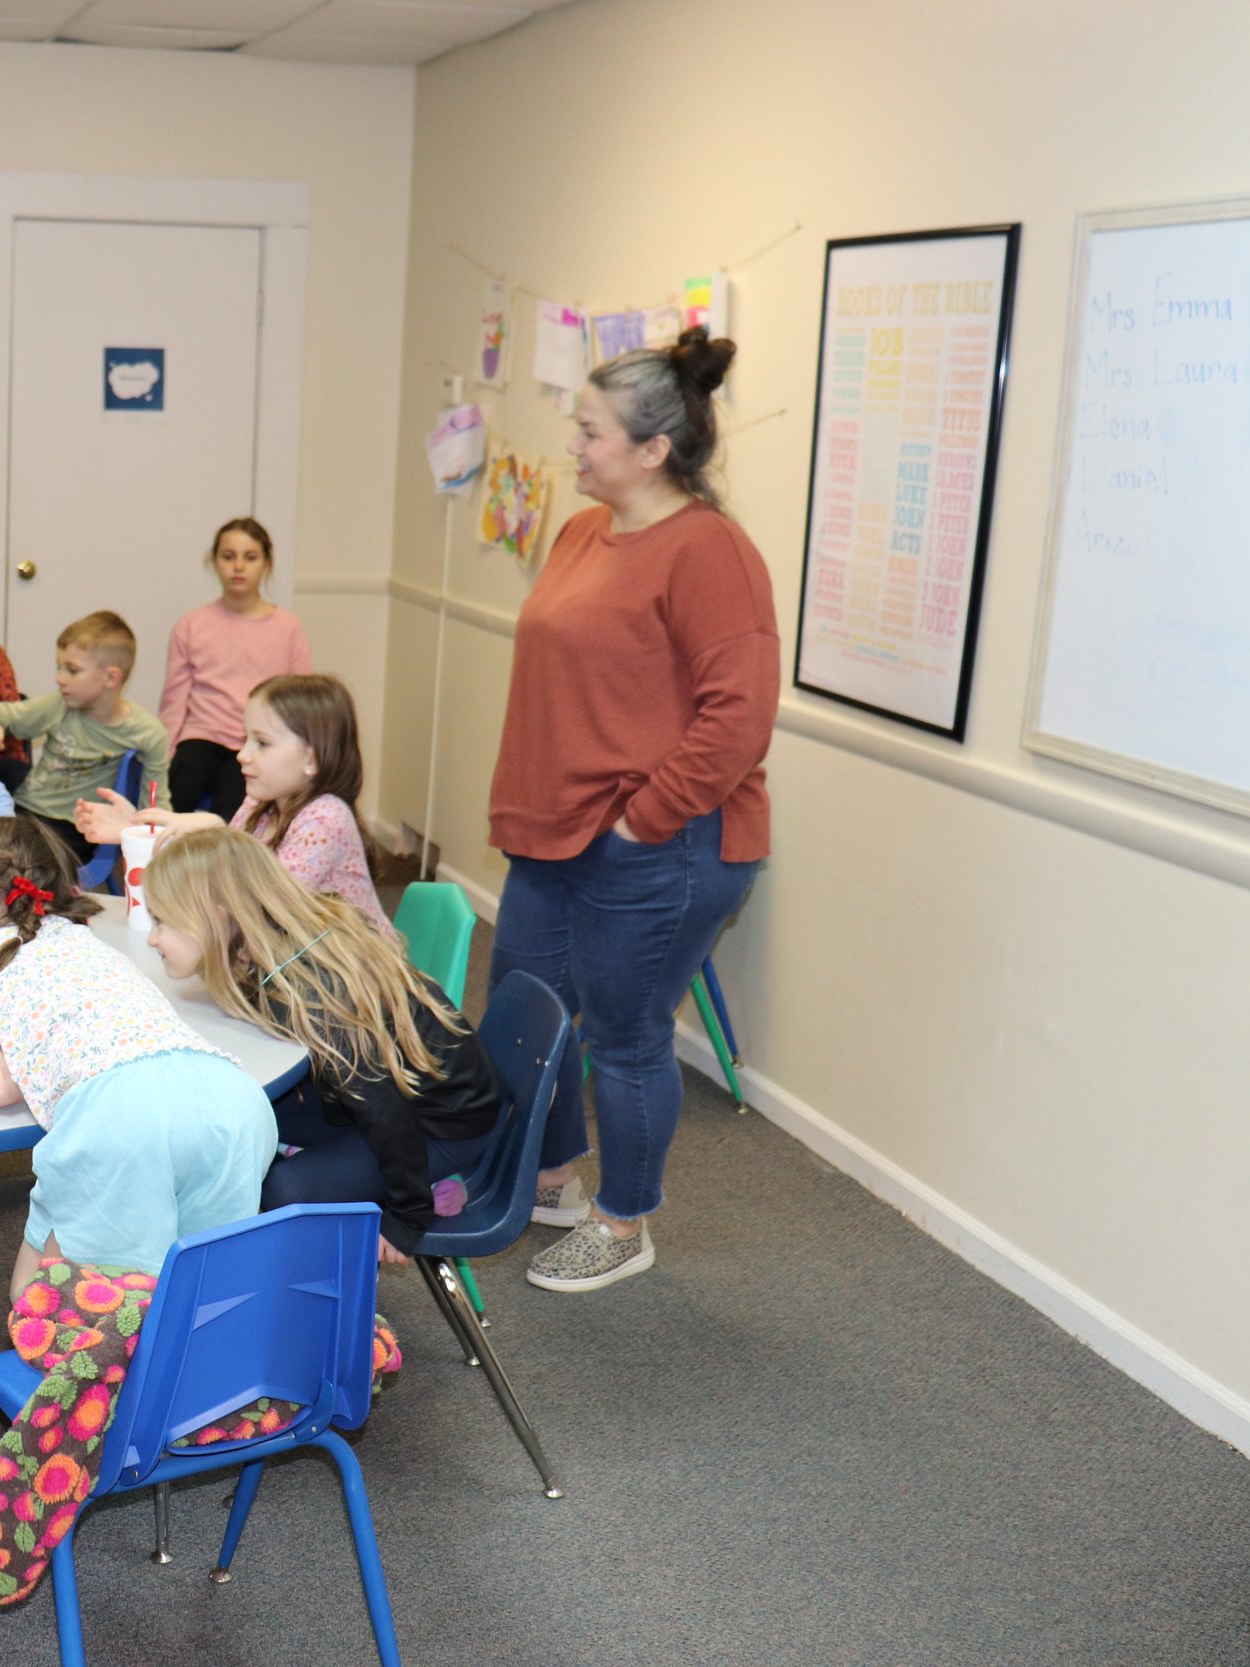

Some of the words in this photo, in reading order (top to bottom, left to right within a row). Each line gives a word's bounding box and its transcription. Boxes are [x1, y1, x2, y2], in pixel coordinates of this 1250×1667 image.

[885, 284, 909, 314] OF
[910, 283, 943, 315] THE
[944, 281, 993, 314] BIBLE
[1152, 273, 1234, 327] Emma
[1153, 349, 1238, 387] Laura
[890, 530, 922, 555] ACTS
